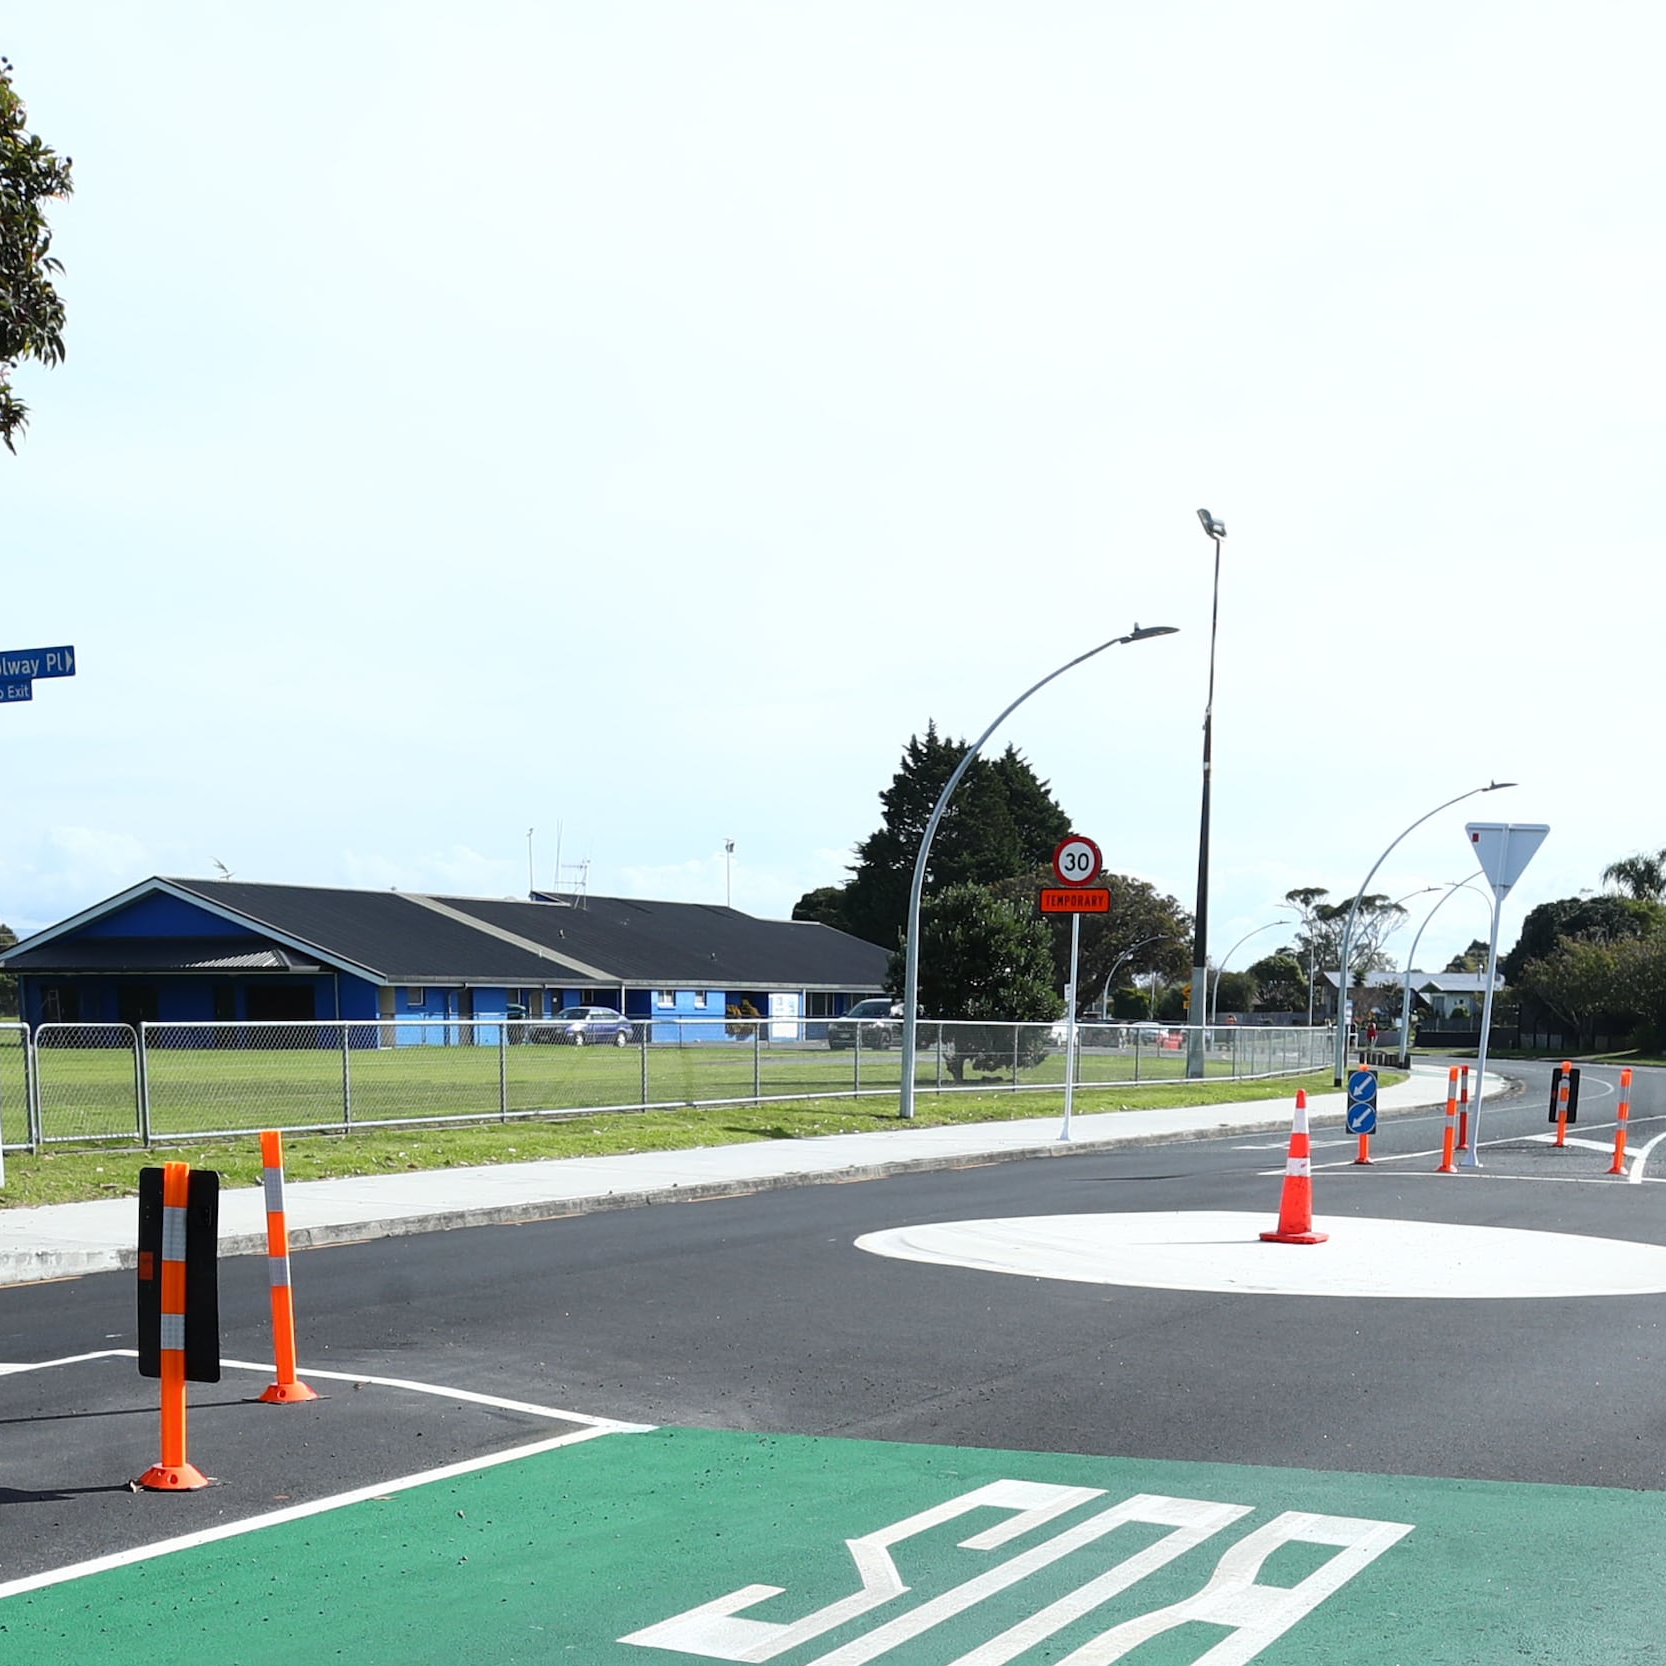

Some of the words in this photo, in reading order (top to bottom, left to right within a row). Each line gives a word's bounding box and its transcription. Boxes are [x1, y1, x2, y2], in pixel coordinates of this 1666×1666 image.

[46, 653, 64, 673] Pl
[8, 685, 30, 699] Exit
[1064, 853, 1090, 872] 30
[1046, 895, 1104, 907] TEMPORARY
